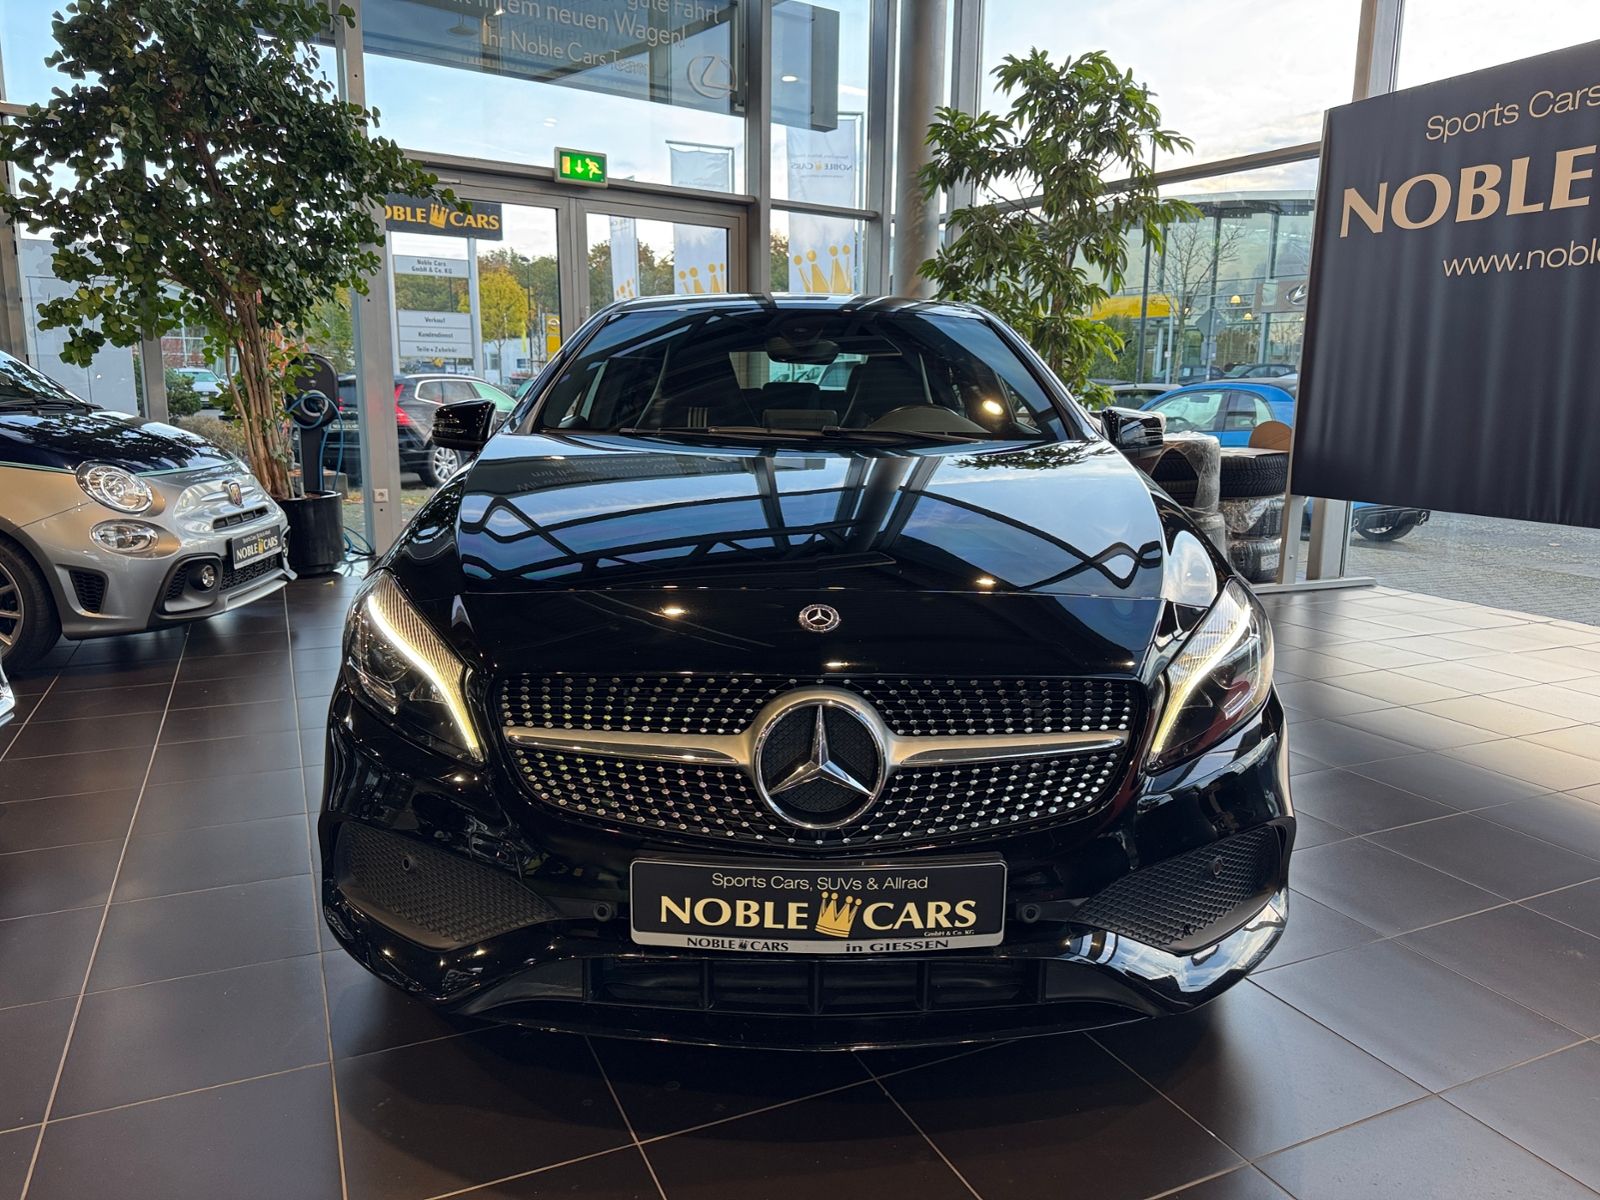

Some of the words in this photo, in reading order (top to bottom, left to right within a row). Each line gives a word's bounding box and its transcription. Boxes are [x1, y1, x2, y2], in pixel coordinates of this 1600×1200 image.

[546, 6, 609, 32] neuen
[673, 0, 720, 24] Fahrt
[511, 30, 564, 59] Noble
[568, 41, 607, 66] Cars
[1425, 102, 1520, 143] Sports
[1339, 144, 1597, 239] NOBLE
[449, 211, 500, 230] CARS
[1443, 237, 1600, 278] www.nobl
[236, 543, 258, 561] NOBLE
[263, 535, 278, 550] CARS
[711, 872, 767, 889] Sports
[770, 875, 813, 892] Cars,
[816, 876, 863, 891] SUVs
[866, 877, 879, 890] &
[882, 876, 929, 890] Allrad
[660, 895, 809, 929] NOBLE
[862, 899, 978, 931] CARS
[686, 937, 736, 950] NOBLE
[750, 940, 789, 952] CARS
[845, 943, 863, 952] in
[869, 939, 950, 952] GIESSEN
